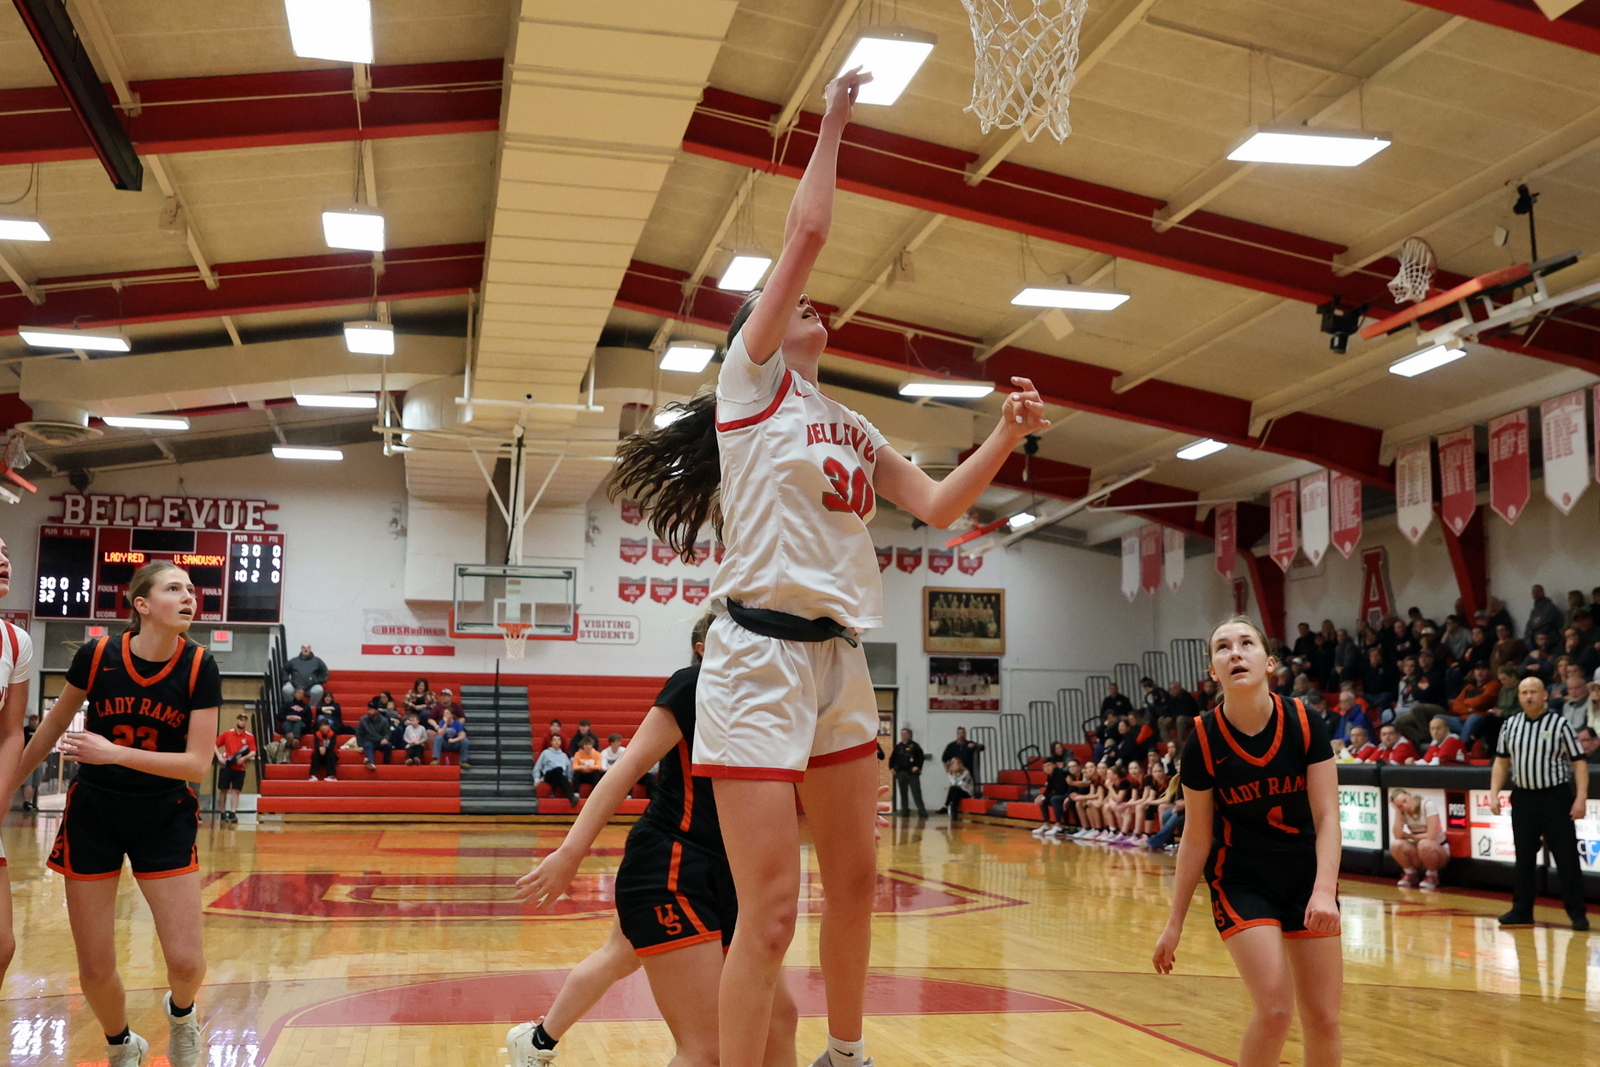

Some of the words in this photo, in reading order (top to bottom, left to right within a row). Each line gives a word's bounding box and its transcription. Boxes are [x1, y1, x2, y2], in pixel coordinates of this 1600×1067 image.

[63, 495, 265, 530] BELLEVUE
[241, 544, 249, 556] 3
[252, 544, 261, 557] 0
[272, 545, 281, 558] 0
[240, 558, 248, 568] 4
[256, 558, 260, 569] 1
[272, 558, 280, 569] 9
[235, 570, 247, 582] 10
[251, 570, 260, 583] 2
[271, 570, 280, 583] 0
[40, 577, 57, 590] 30
[60, 577, 69, 590] 0
[82, 578, 90, 591] 3
[39, 589, 55, 602] 32
[63, 591, 68, 602] 1
[76, 591, 89, 602] 17
[62, 604, 67, 615] 1
[584, 619, 631, 629] VISITING
[579, 630, 634, 640] STUDENTS
[95, 696, 137, 717] LADY
[139, 698, 185, 728] RAMS
[112, 725, 158, 750] 23
[1219, 781, 1262, 805] LADY
[1267, 775, 1307, 795] RAM
